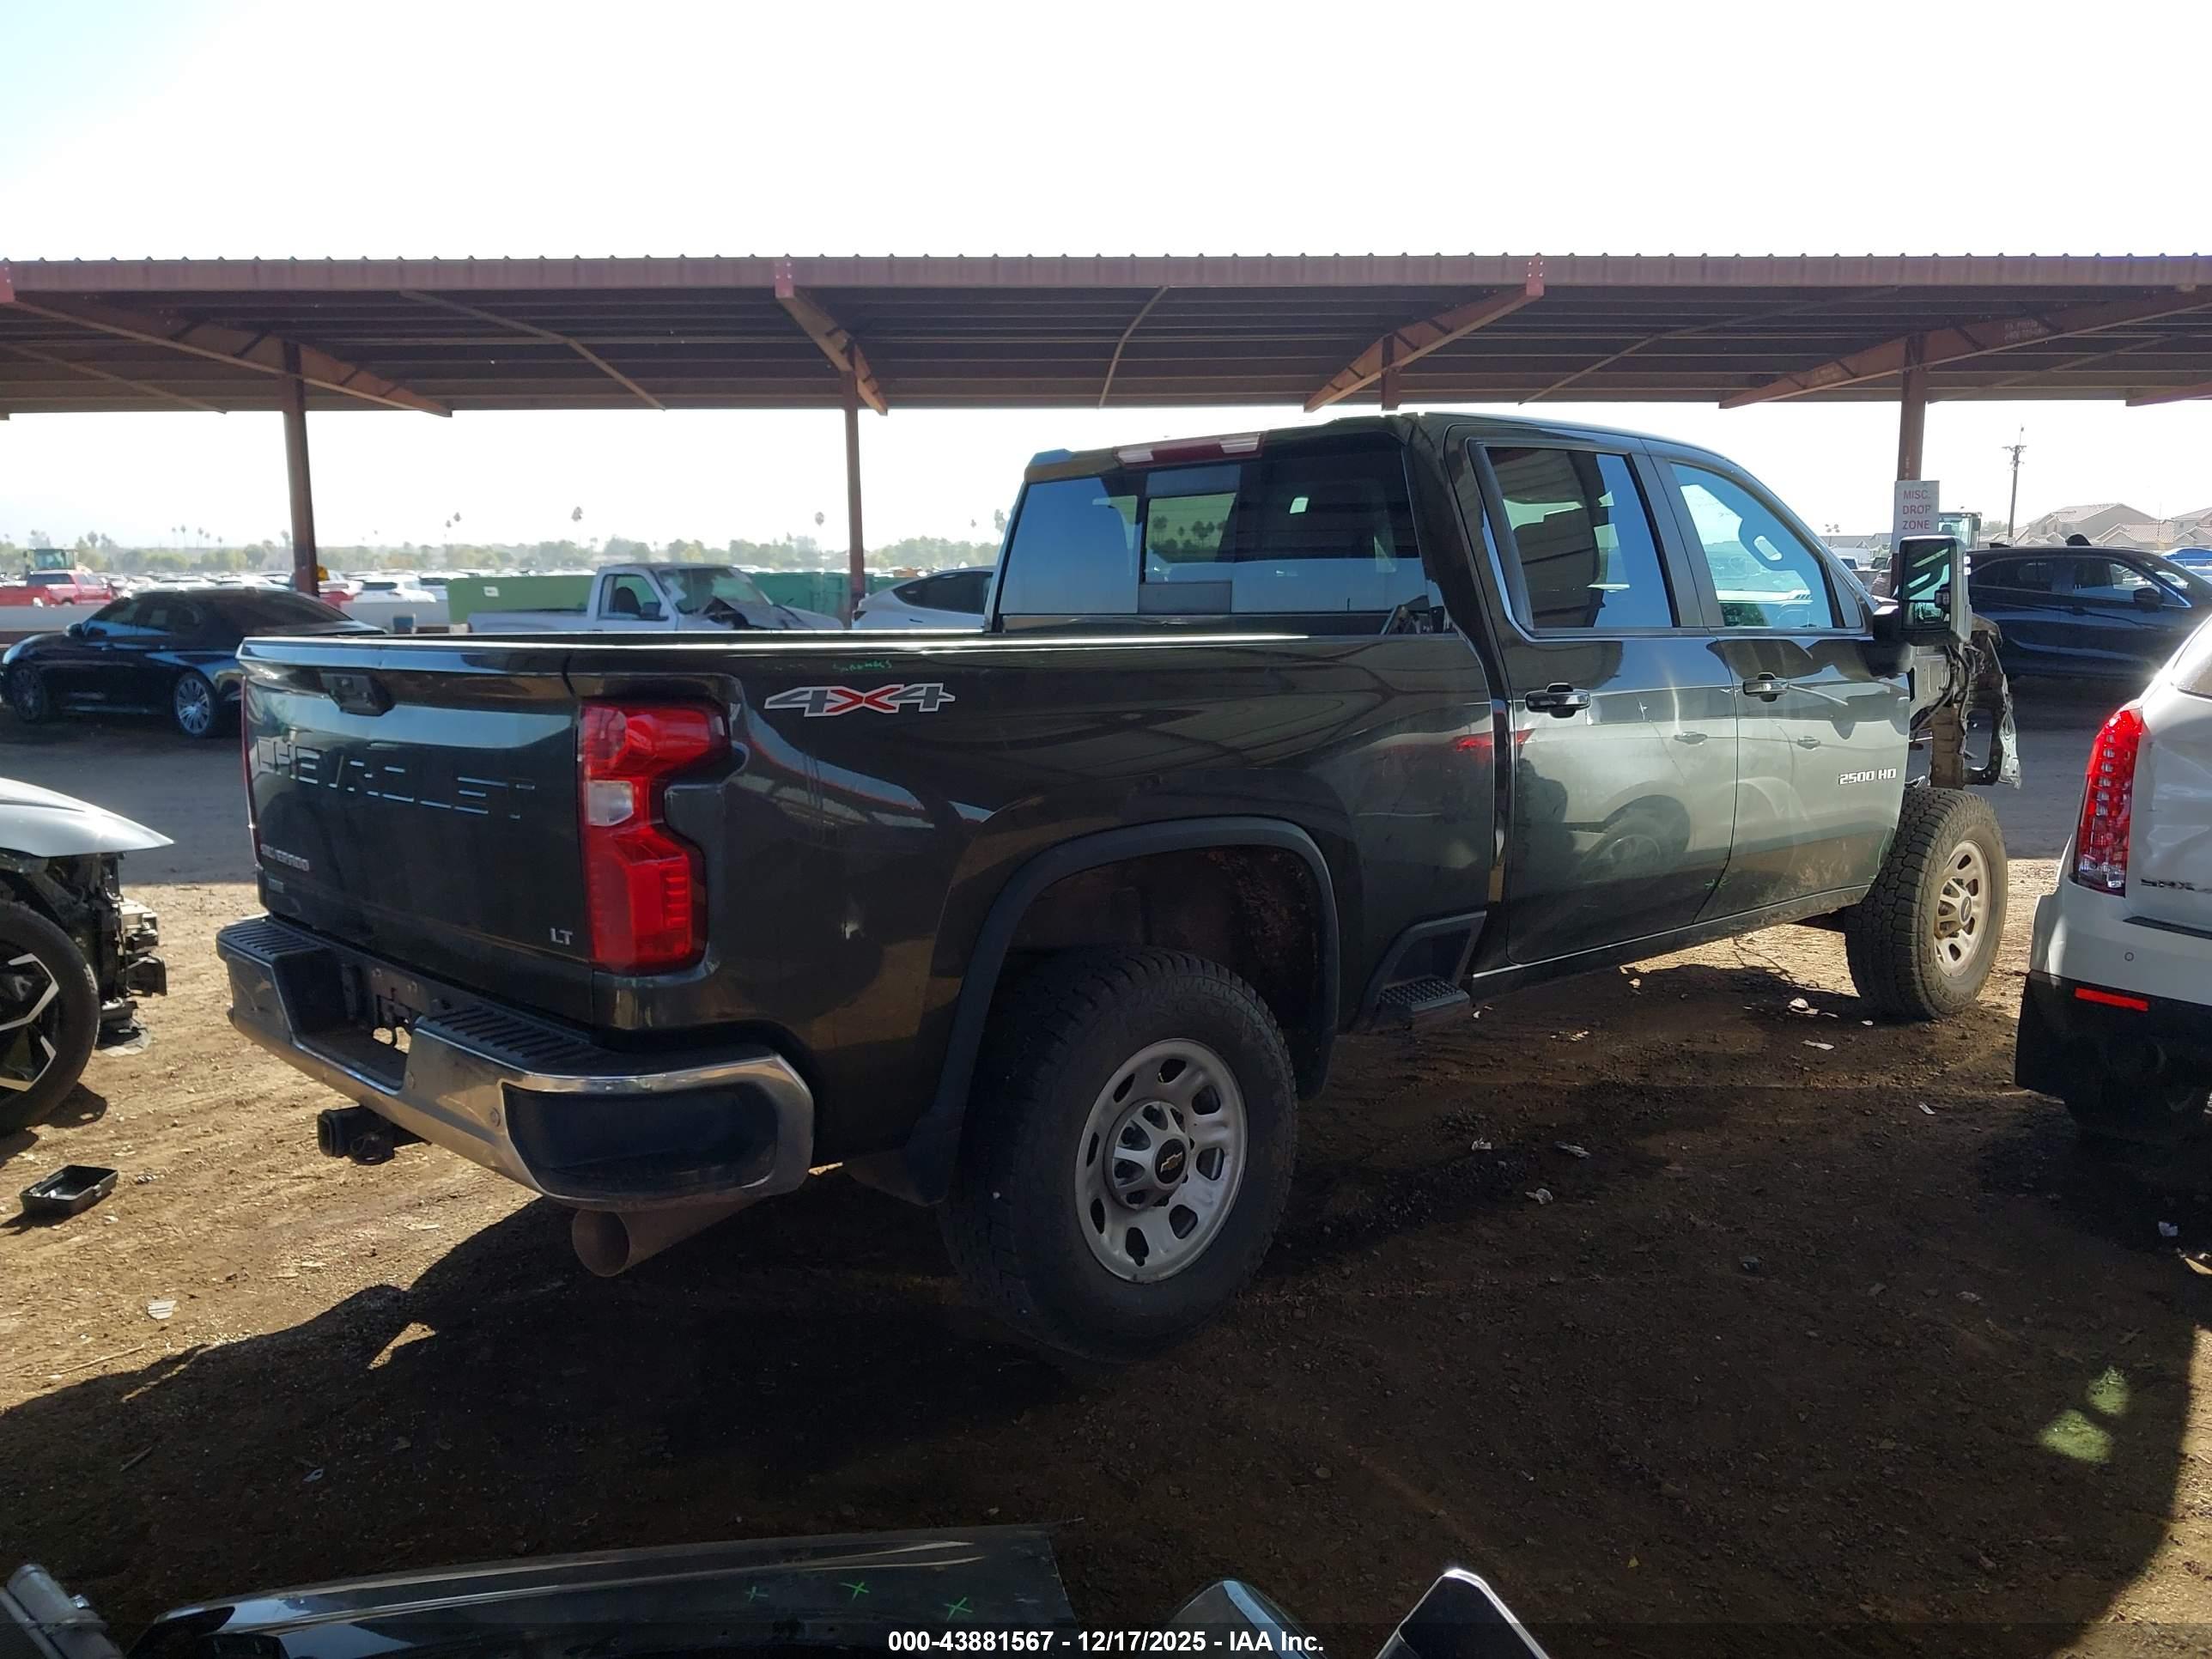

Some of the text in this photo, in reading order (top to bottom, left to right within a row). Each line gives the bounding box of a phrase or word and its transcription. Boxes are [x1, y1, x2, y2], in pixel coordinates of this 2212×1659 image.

[1903, 489, 1930, 500] MISC.
[1902, 505, 1930, 514] DROP
[1902, 520, 1930, 530] ZONE
[1838, 768, 1897, 785] 2500 HD
[550, 927, 573, 945] LT
